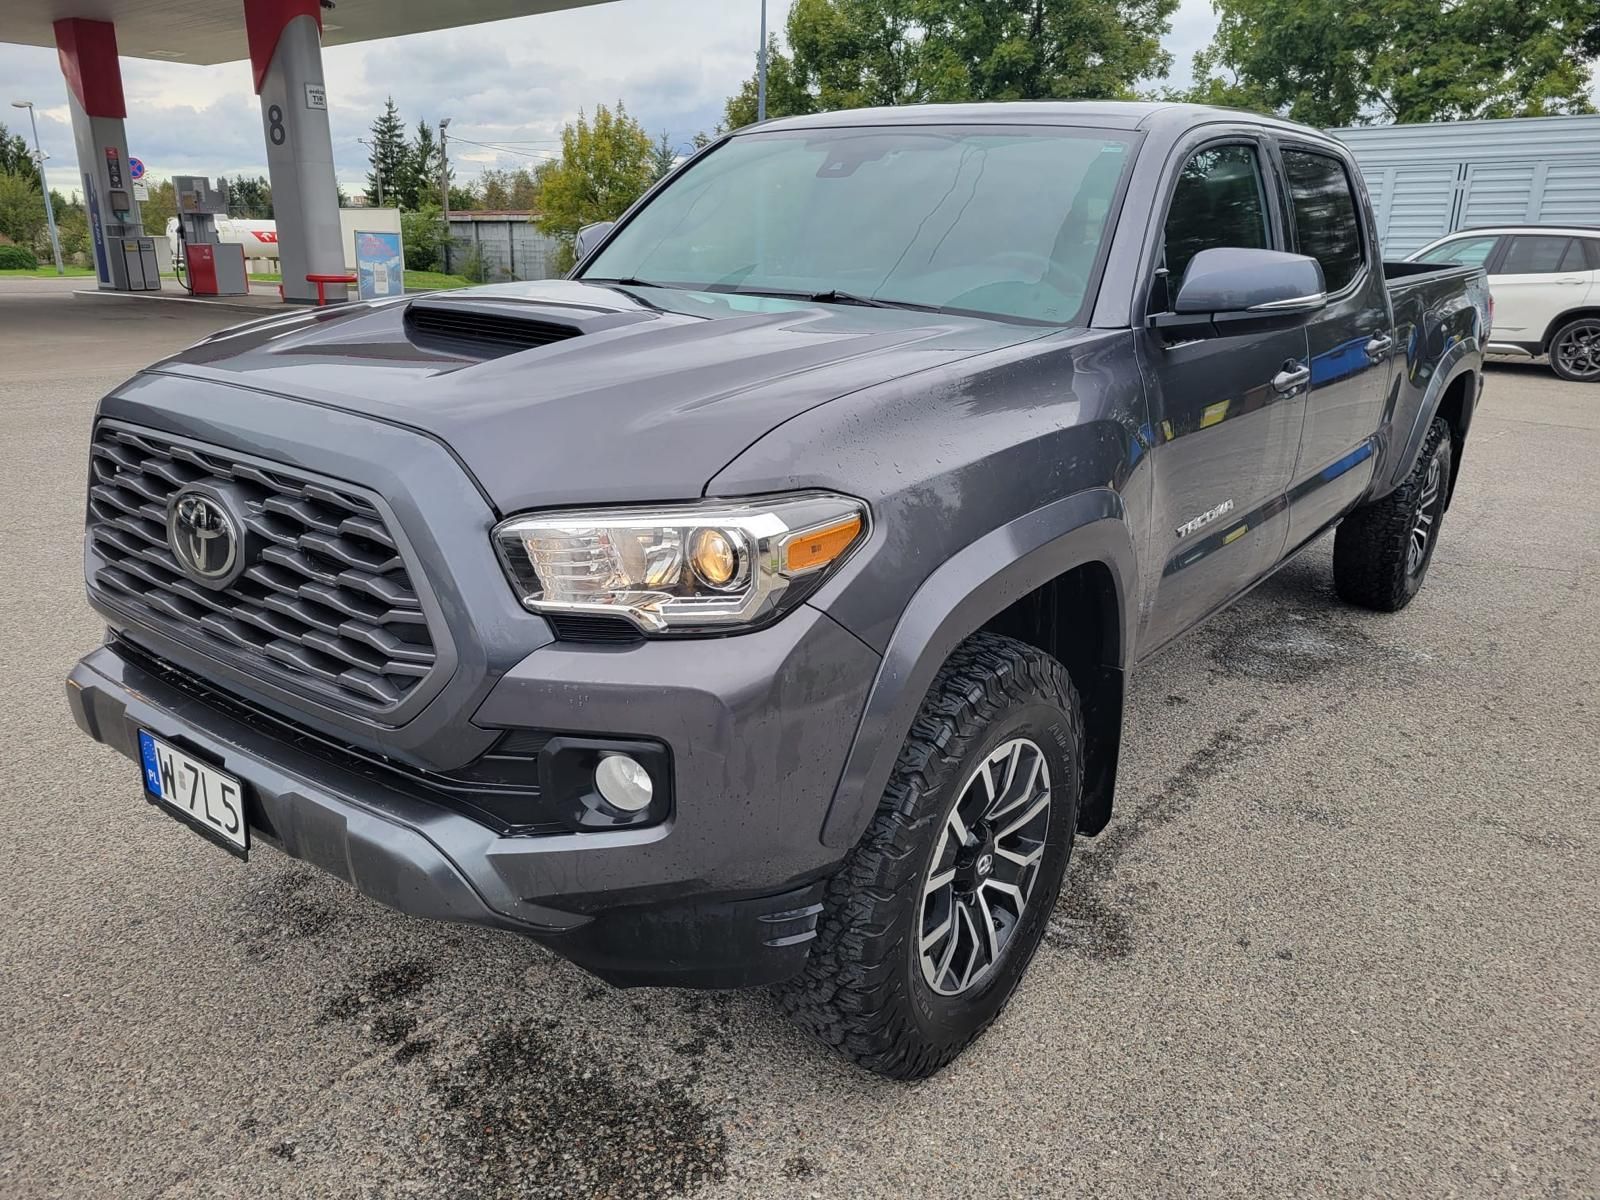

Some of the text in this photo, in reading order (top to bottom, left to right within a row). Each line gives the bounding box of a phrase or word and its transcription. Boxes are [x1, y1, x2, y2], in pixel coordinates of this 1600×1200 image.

[268, 104, 285, 145] 8
[1176, 498, 1233, 538] TACOMA
[148, 768, 160, 785] PL
